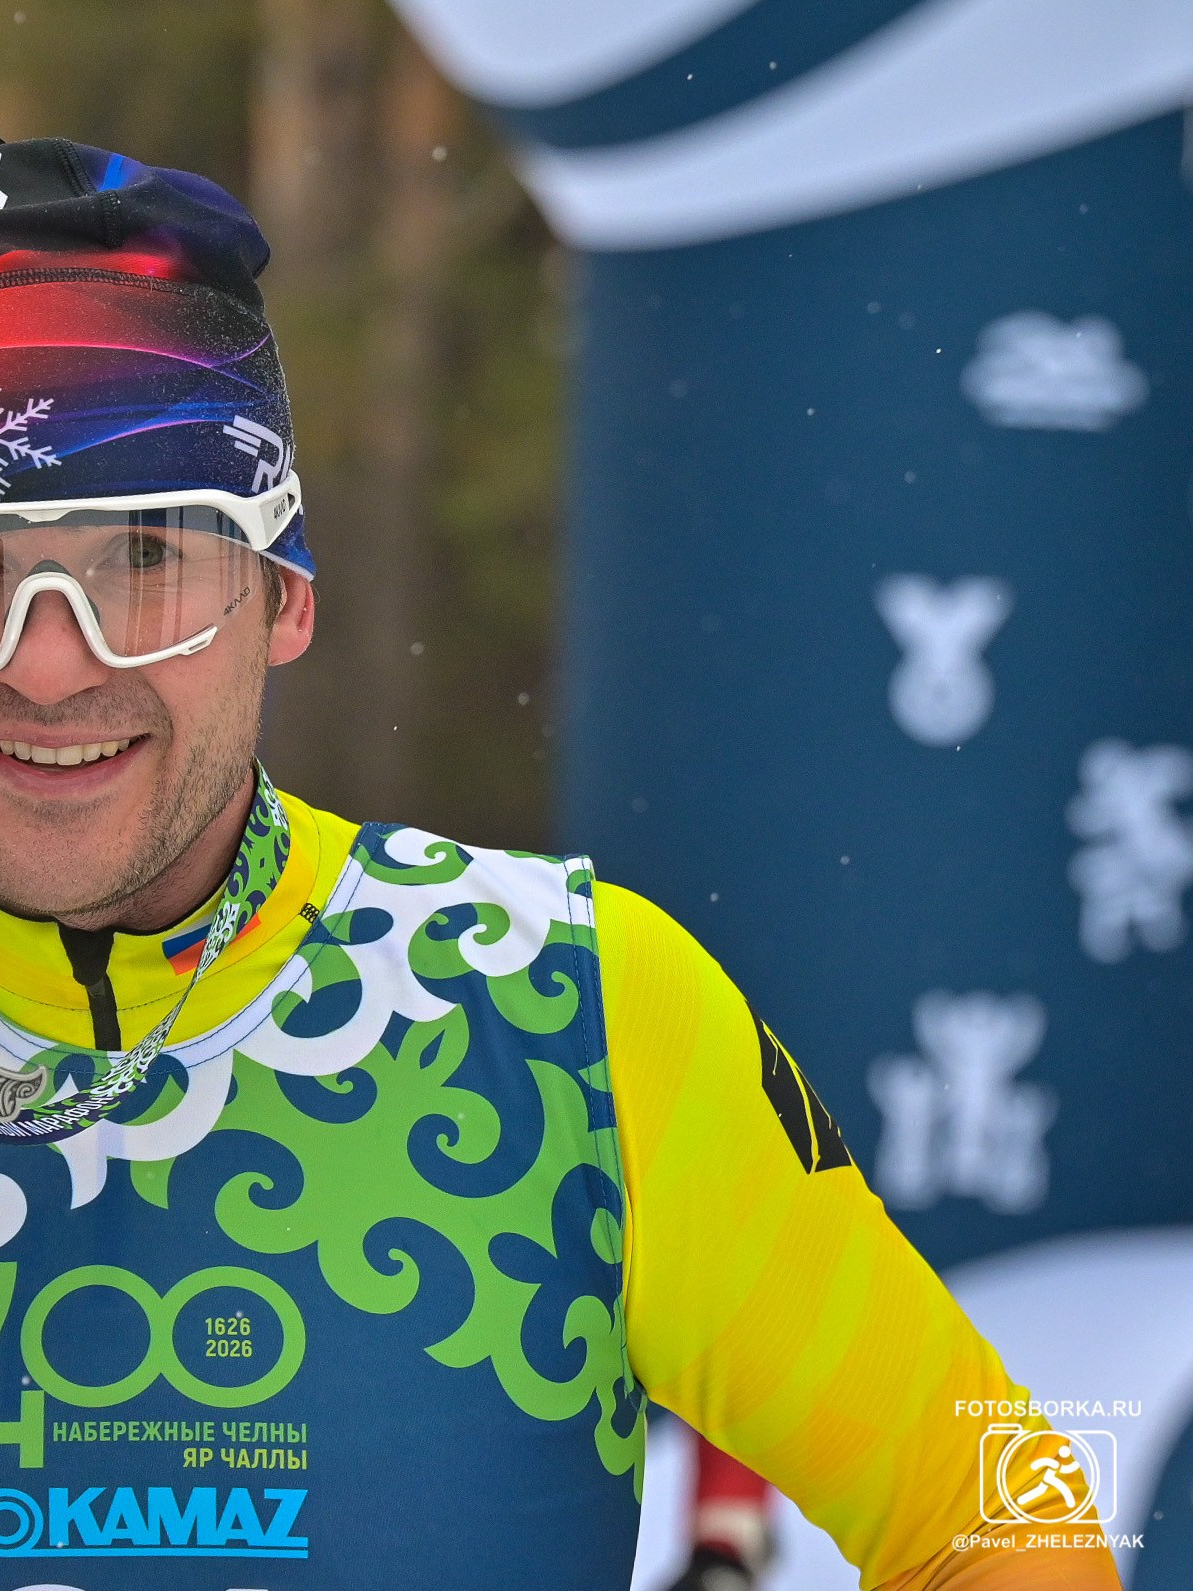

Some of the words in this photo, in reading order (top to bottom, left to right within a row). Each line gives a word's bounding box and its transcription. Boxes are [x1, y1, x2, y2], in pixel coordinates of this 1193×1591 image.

[17, 1097, 113, 1136] МАРАФОН
[205, 1317, 251, 1336] 1626
[205, 1339, 253, 1358] 2026
[52, 1421, 215, 1442] НАБЕРЕЖНЫЕ
[222, 1421, 307, 1443] ЧЕЛНЫ
[182, 1447, 214, 1469] ЯР
[220, 1447, 307, 1470] ЧАЛЛЫ
[49, 1487, 308, 1547] KAMAZ
